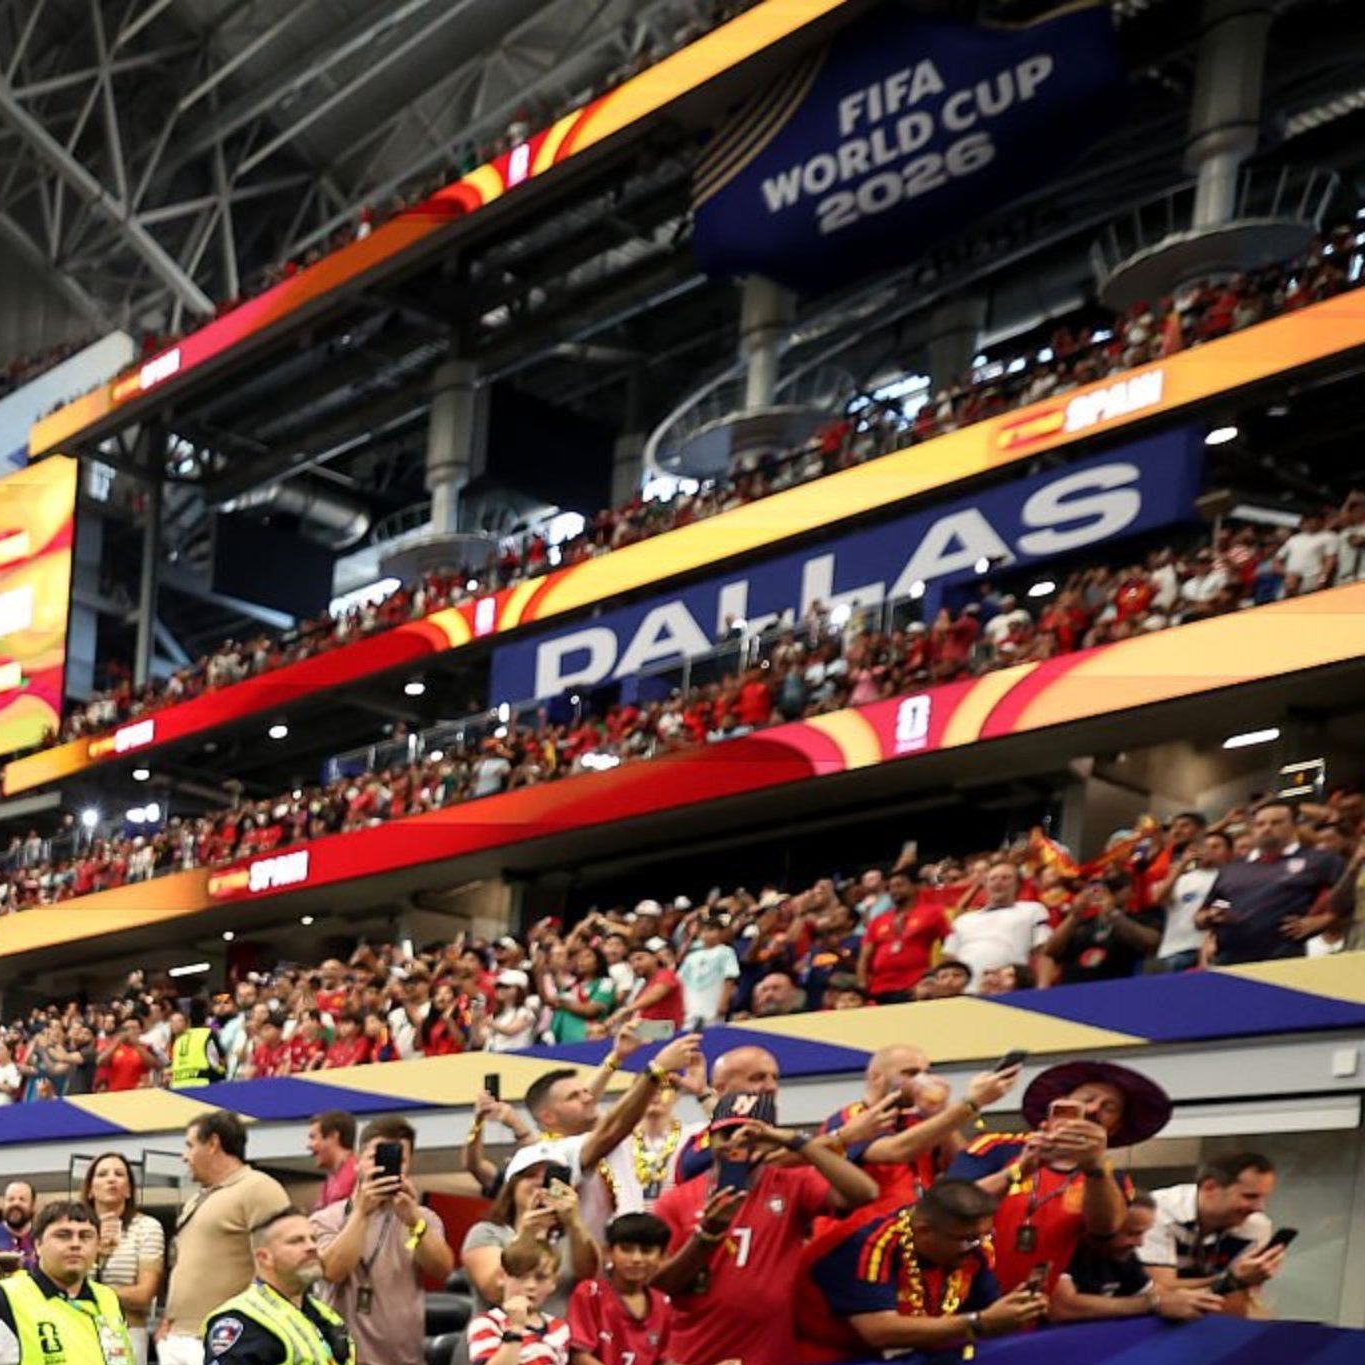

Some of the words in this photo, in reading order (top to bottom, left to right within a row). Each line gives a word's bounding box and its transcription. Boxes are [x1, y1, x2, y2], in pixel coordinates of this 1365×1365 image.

[762, 112, 933, 213] WORLD
[942, 54, 1054, 129] CUP
[839, 60, 945, 137] FIFA
[816, 132, 996, 234] 2026
[534, 462, 1142, 700] DALLAS
[732, 1227, 752, 1268] 7
